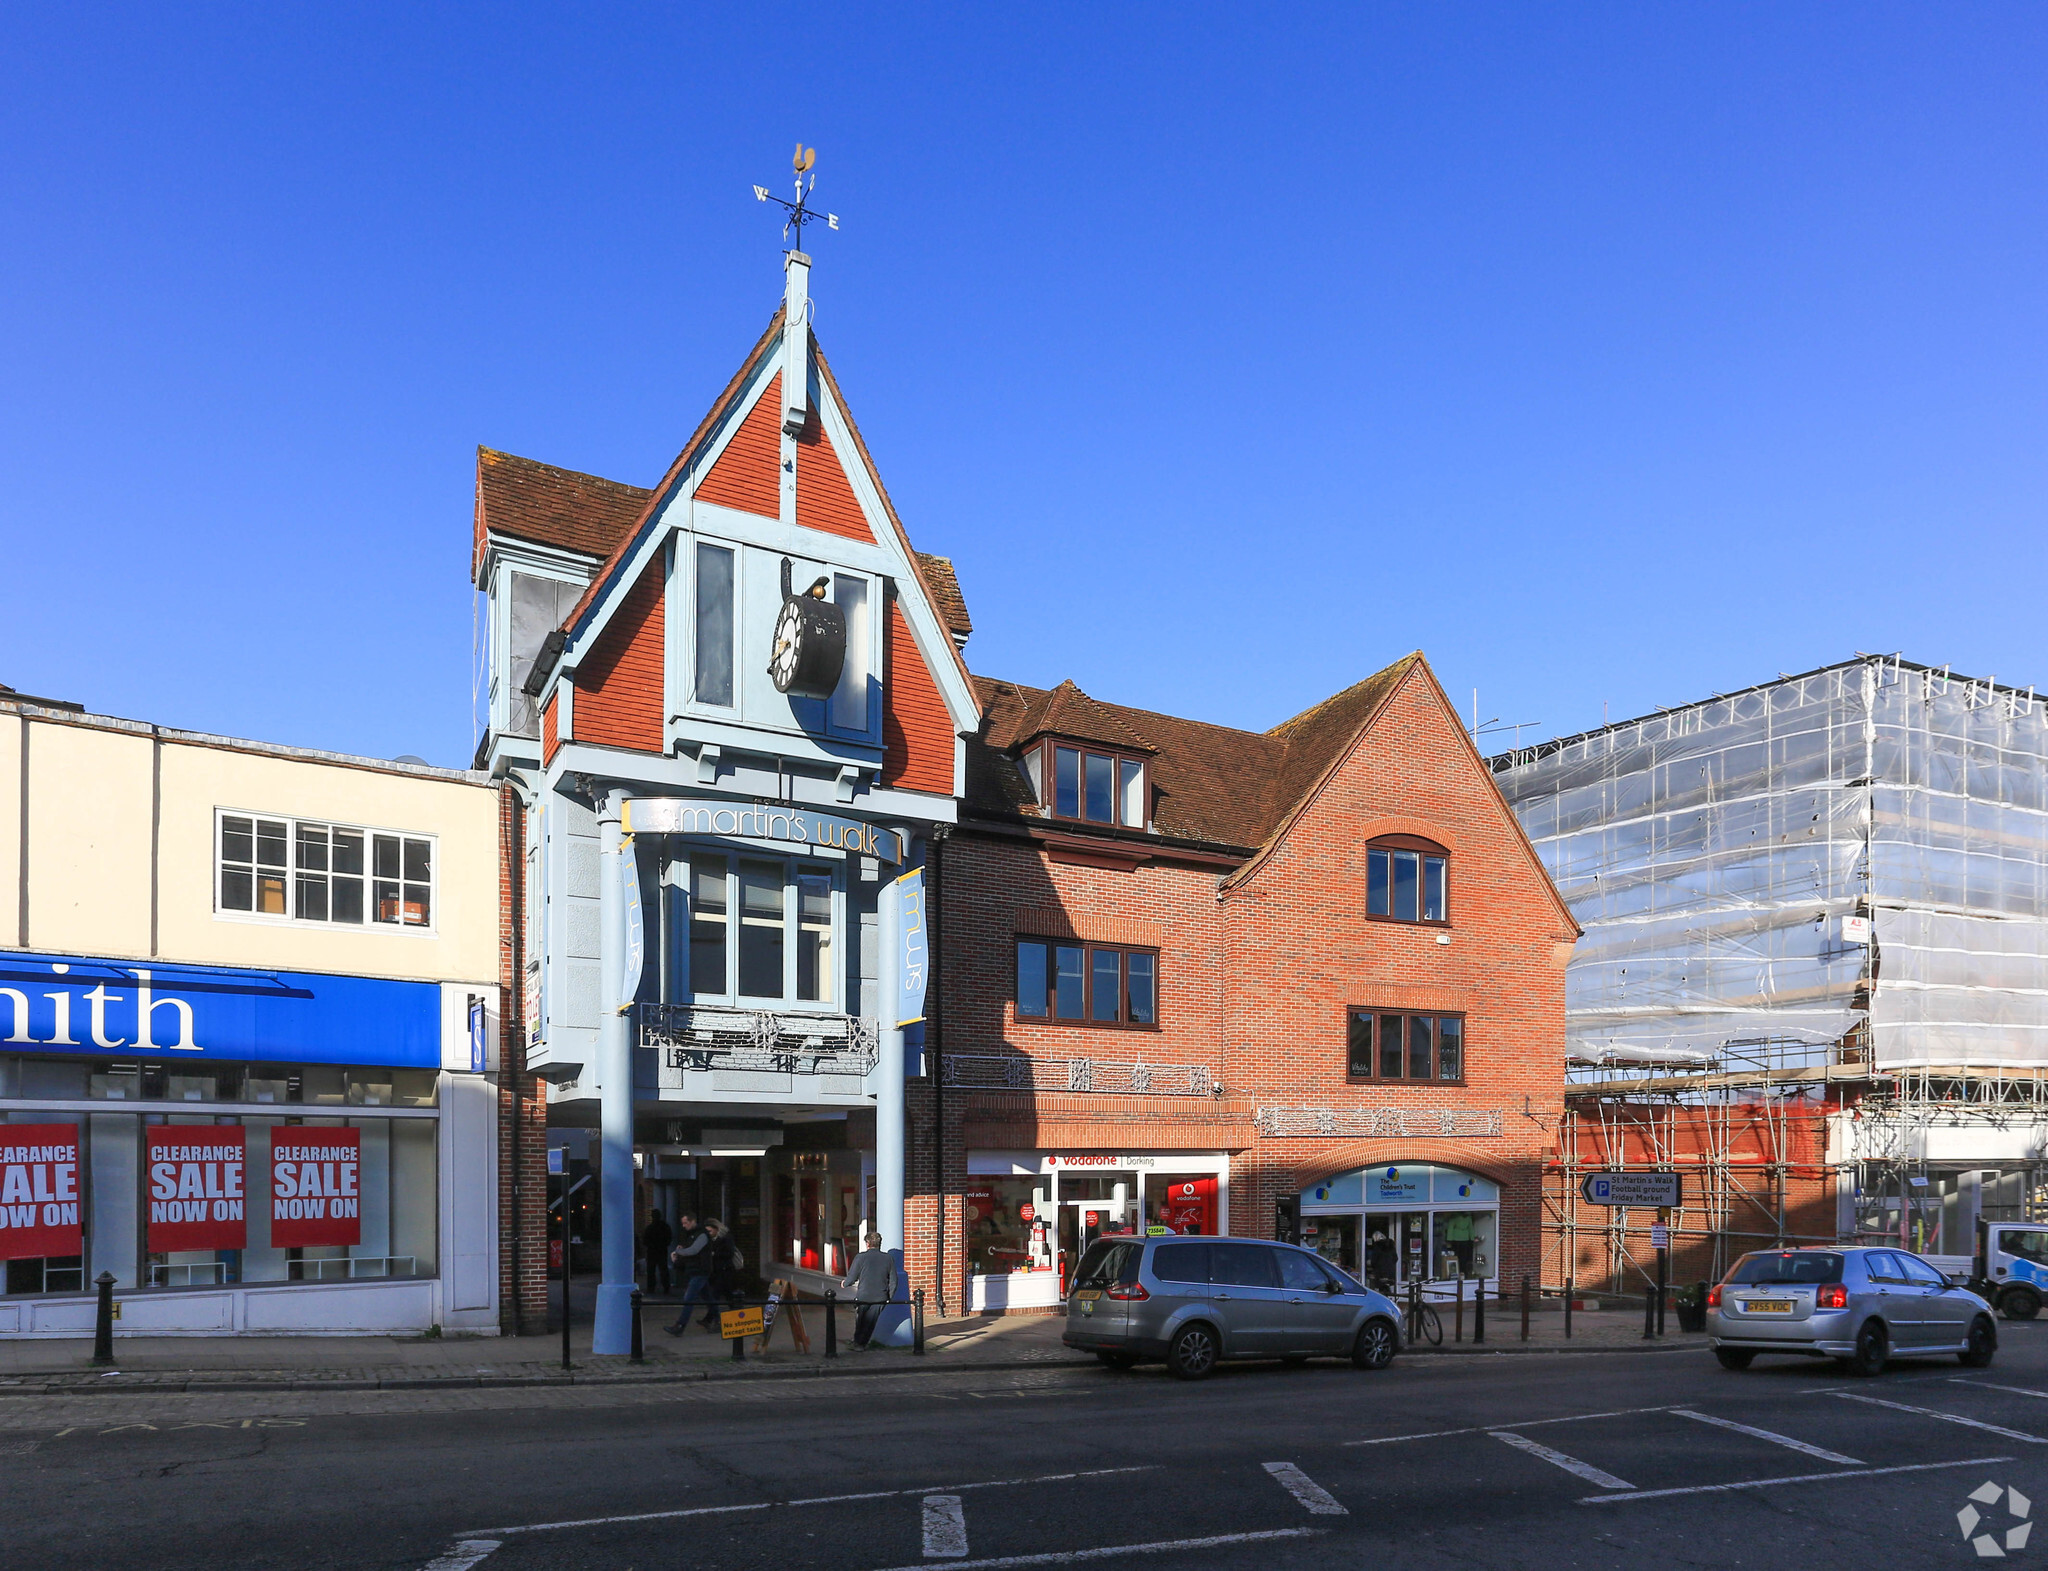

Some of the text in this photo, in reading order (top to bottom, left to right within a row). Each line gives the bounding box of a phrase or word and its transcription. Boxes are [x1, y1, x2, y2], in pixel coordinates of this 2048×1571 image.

[681, 803, 808, 844] martin's
[817, 822, 881, 857] walk
[0, 1145, 76, 1163] ARANCE
[151, 1145, 243, 1161] CLEARANCE
[274, 1146, 358, 1161] CLEARANCE
[1063, 1154, 1155, 1167] vodafone Dorking
[0, 1163, 78, 1204] ALE
[151, 1162, 244, 1200] SALE
[274, 1162, 358, 1198] SALE
[1611, 1176, 1674, 1184] St Martin's Walk
[1611, 1185, 1671, 1194] Football ground
[1611, 1194, 1663, 1203] Friday Market
[43, 1202, 78, 1227] ON
[152, 1200, 244, 1223] NOW ON
[274, 1198, 358, 1220] NOW ON
